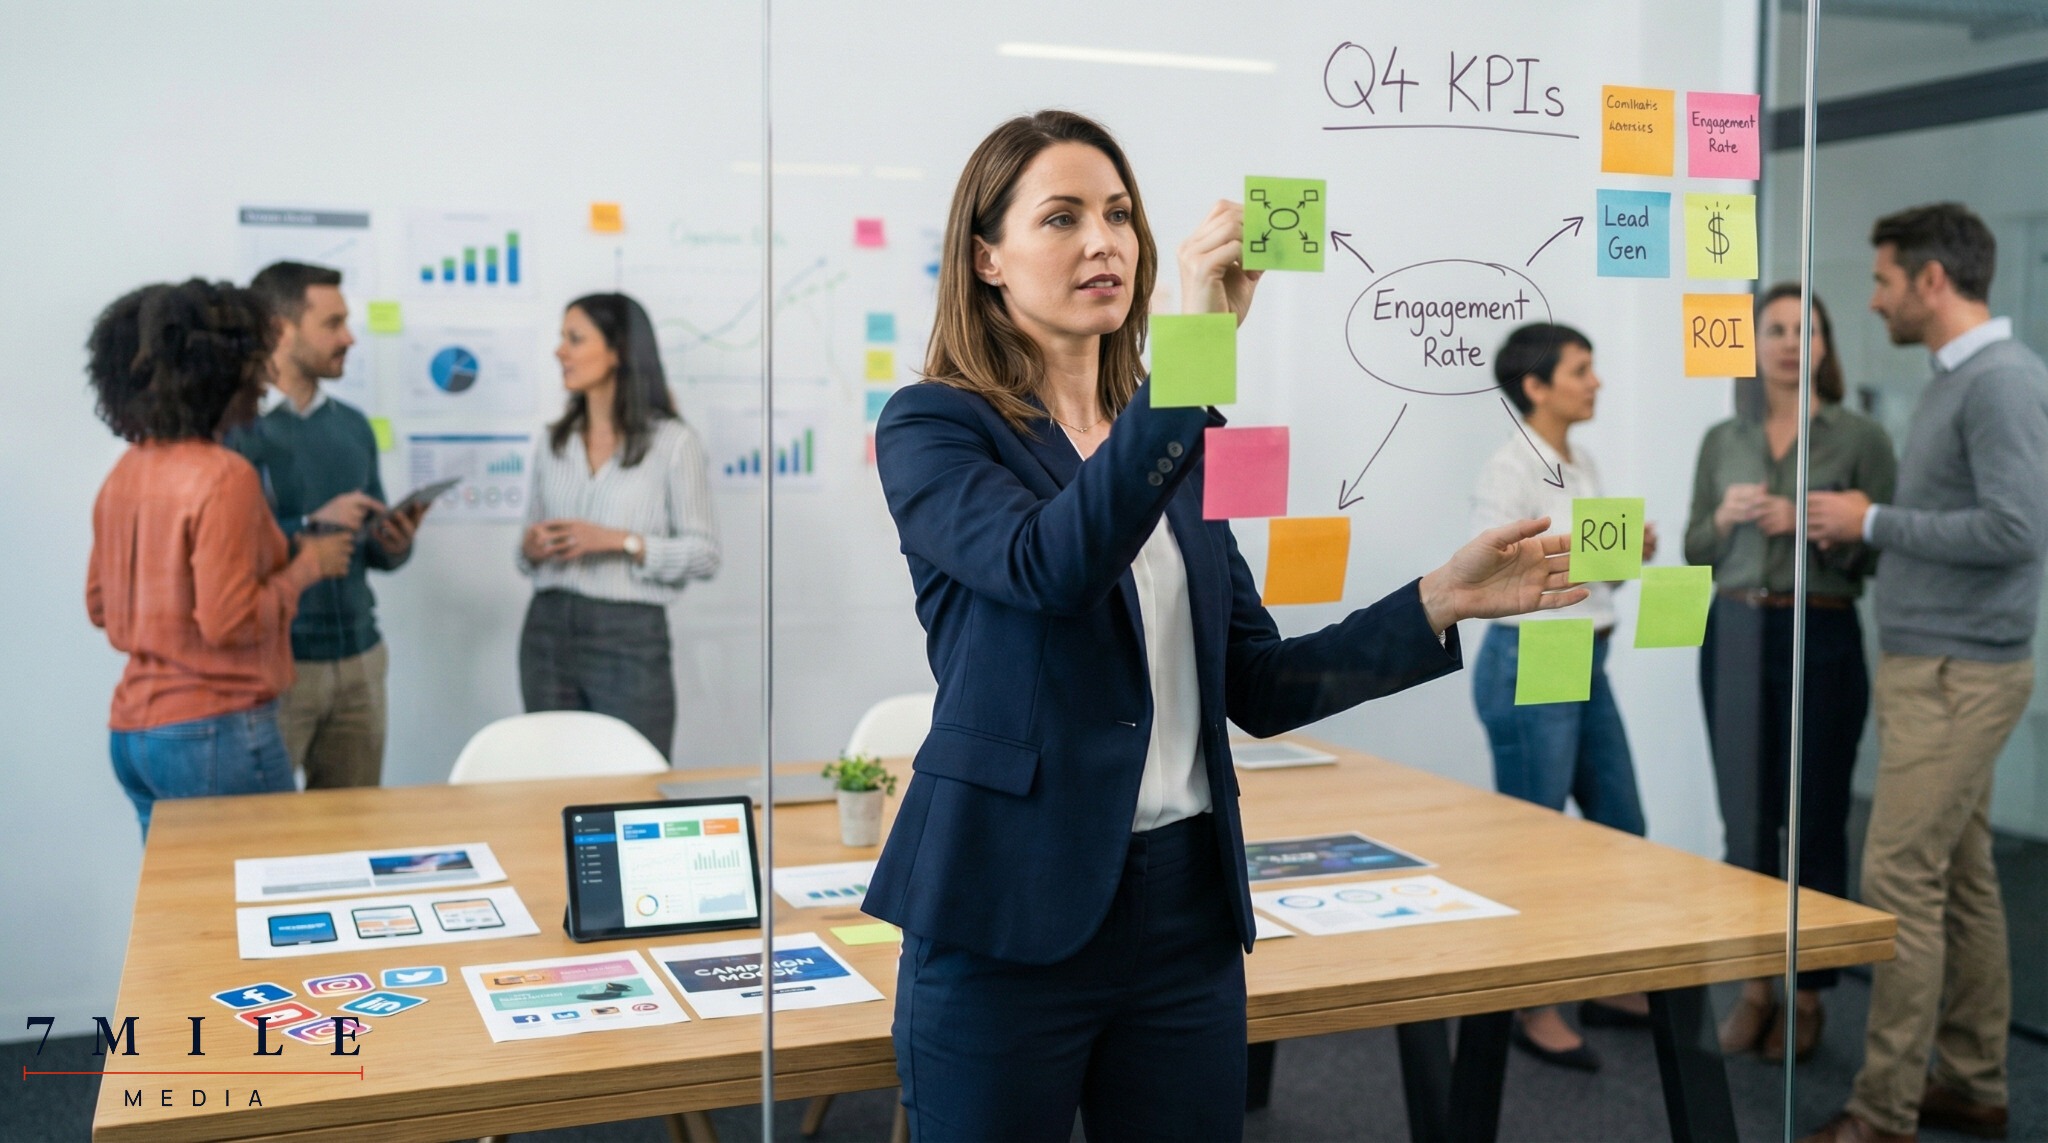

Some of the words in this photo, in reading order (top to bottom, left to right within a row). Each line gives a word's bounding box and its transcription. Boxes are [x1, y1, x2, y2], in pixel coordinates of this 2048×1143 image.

[1323, 40, 1420, 115] Q4
[1448, 50, 1565, 118] KPIs
[1691, 110, 1756, 135] Engagement
[1708, 137, 1739, 154] Rate
[1604, 204, 1650, 228] Lead
[1608, 235, 1647, 260] Gen
[1373, 288, 1530, 338] Engagement
[1692, 315, 1745, 349] ROI
[1424, 336, 1486, 368] Rate
